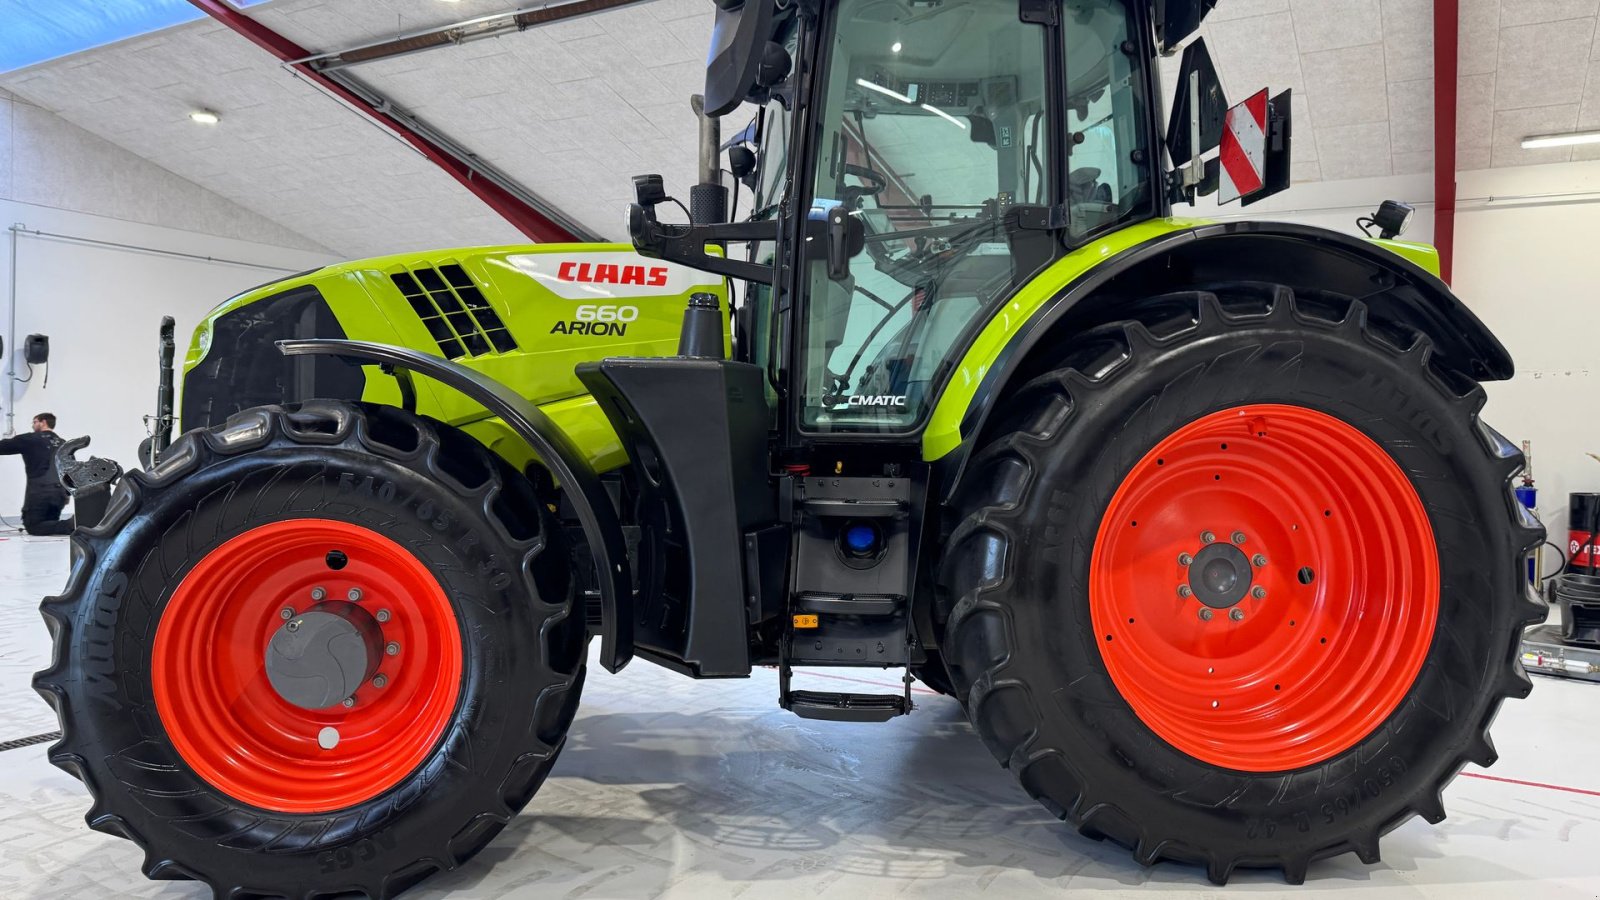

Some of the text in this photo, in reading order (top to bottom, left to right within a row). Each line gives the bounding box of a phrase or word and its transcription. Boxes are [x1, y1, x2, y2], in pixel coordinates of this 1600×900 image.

[557, 261, 669, 287] CLAAS
[575, 304, 639, 322] 660
[550, 320, 627, 337] ARION
[848, 395, 907, 406] CMATIC
[1320, 755, 1408, 825] 650/65
[1246, 818, 1277, 840] 42
